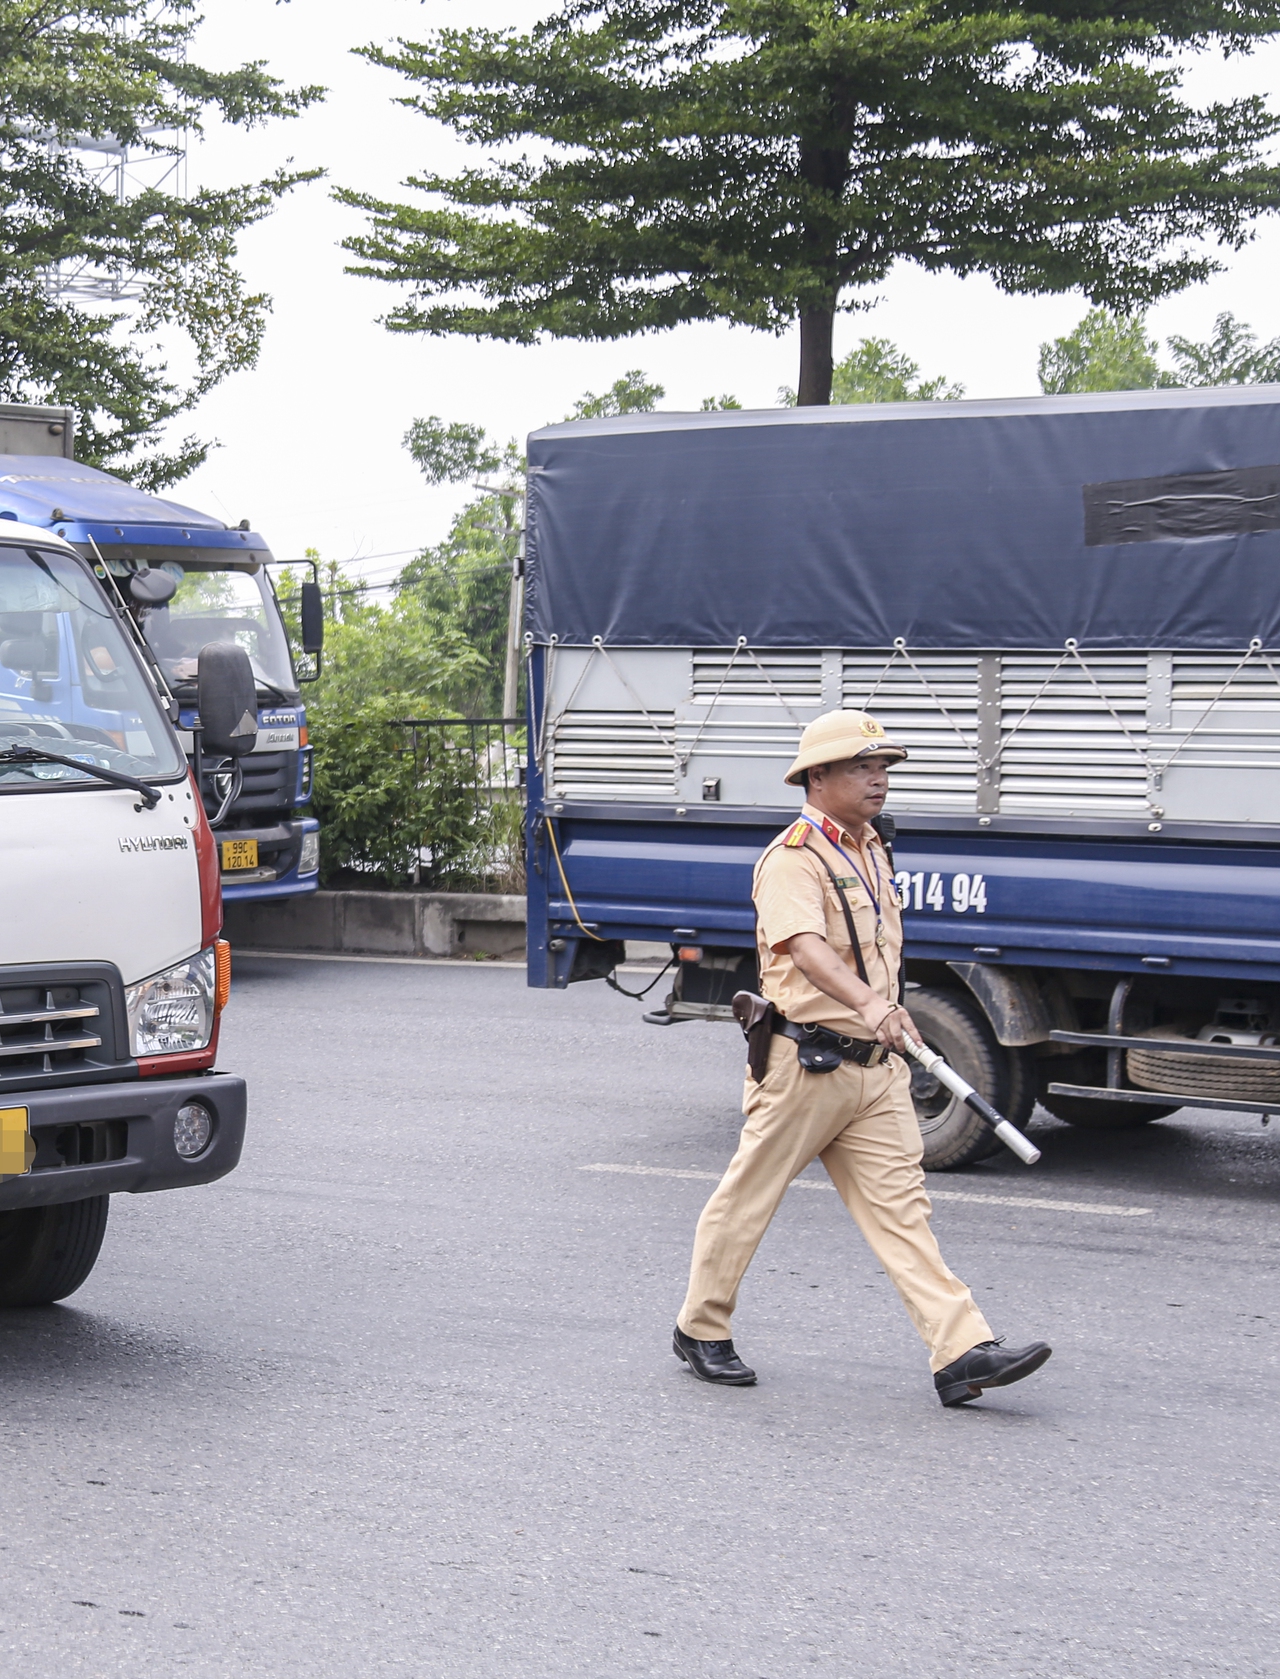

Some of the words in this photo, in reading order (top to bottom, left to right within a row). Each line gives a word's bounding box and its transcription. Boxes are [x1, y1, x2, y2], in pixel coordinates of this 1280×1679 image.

[262, 714, 296, 724] FOTON
[119, 834, 188, 852] HYUNDAI
[232, 841, 248, 855] 99C
[227, 855, 255, 868] 120.14
[895, 871, 945, 912] 314
[951, 873, 988, 914] 94
